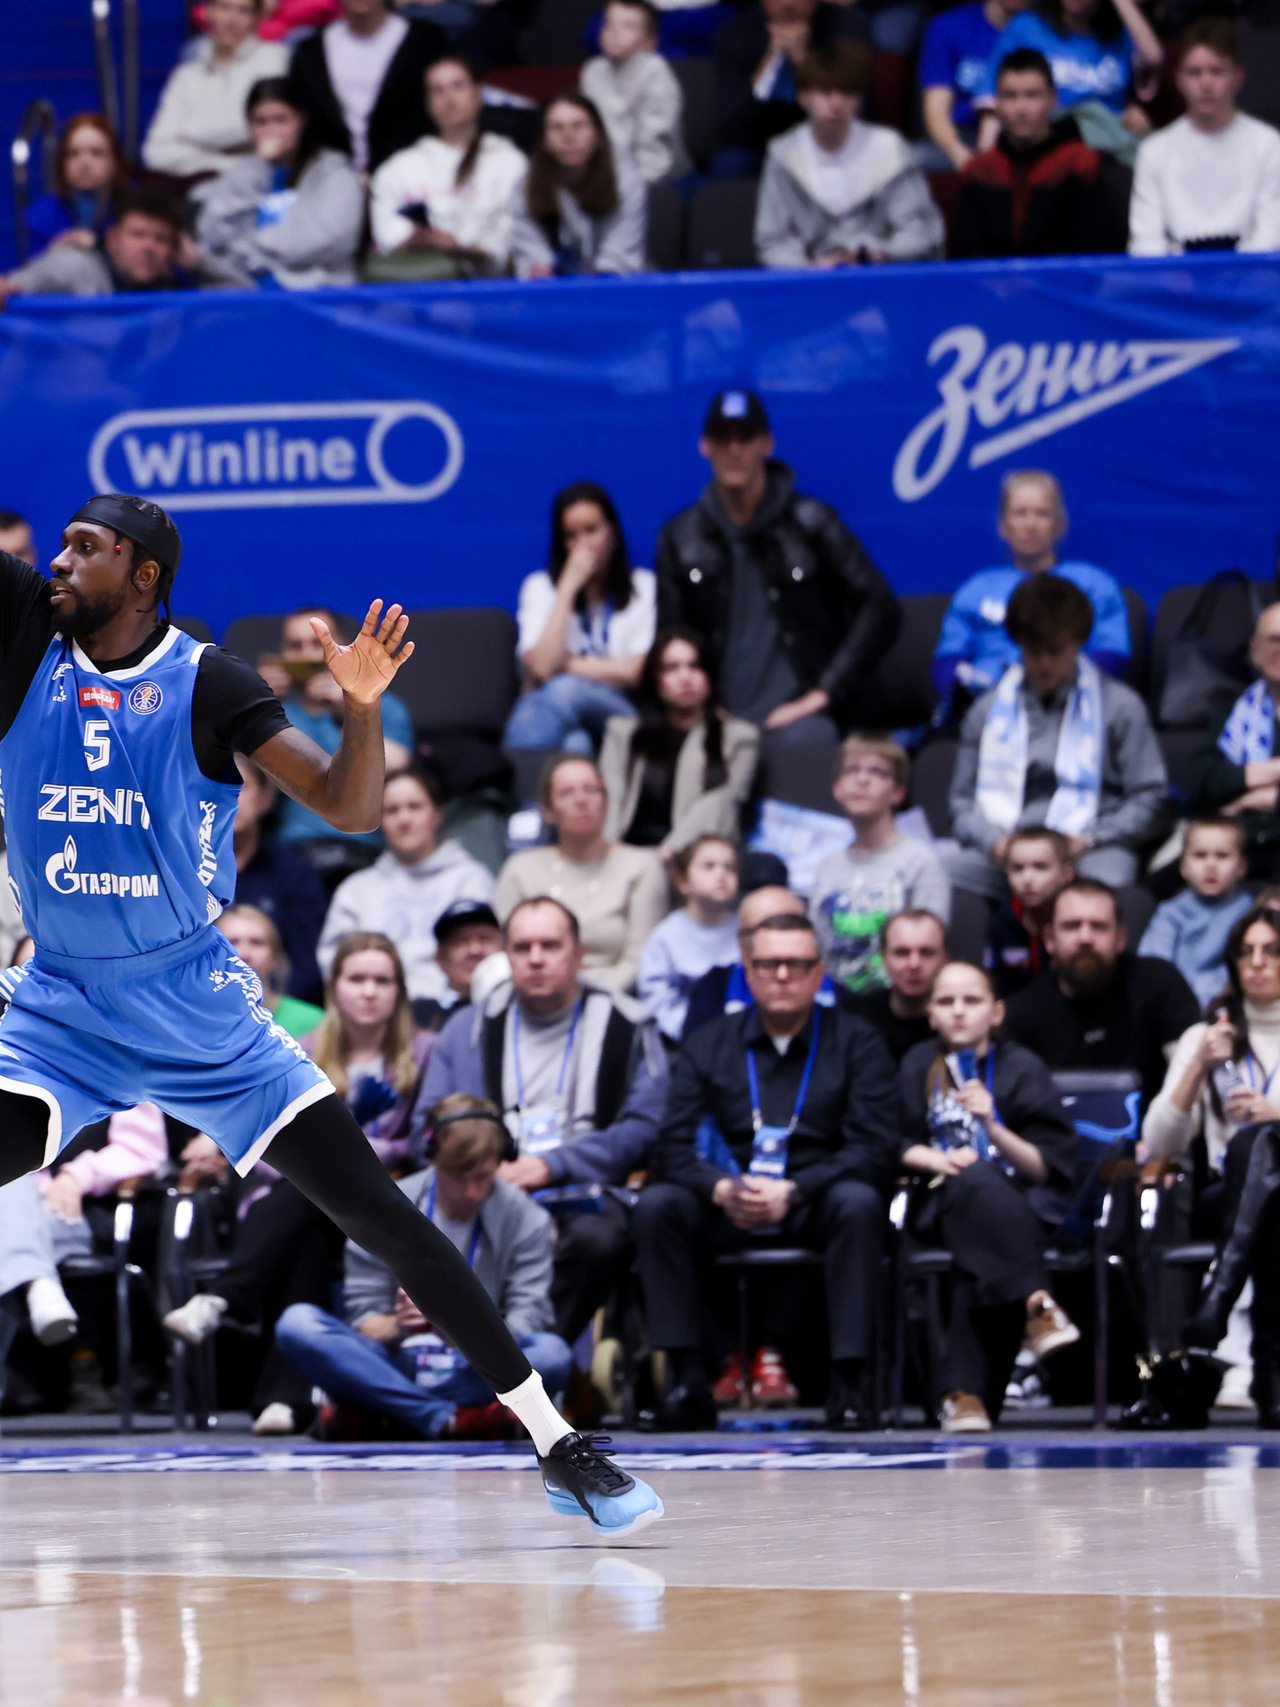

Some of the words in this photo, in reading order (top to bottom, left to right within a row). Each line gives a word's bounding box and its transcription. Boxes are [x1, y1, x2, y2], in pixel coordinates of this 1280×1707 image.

[123, 427, 357, 489] Winline
[83, 719, 111, 771] 5
[38, 783, 150, 830] ZENIT
